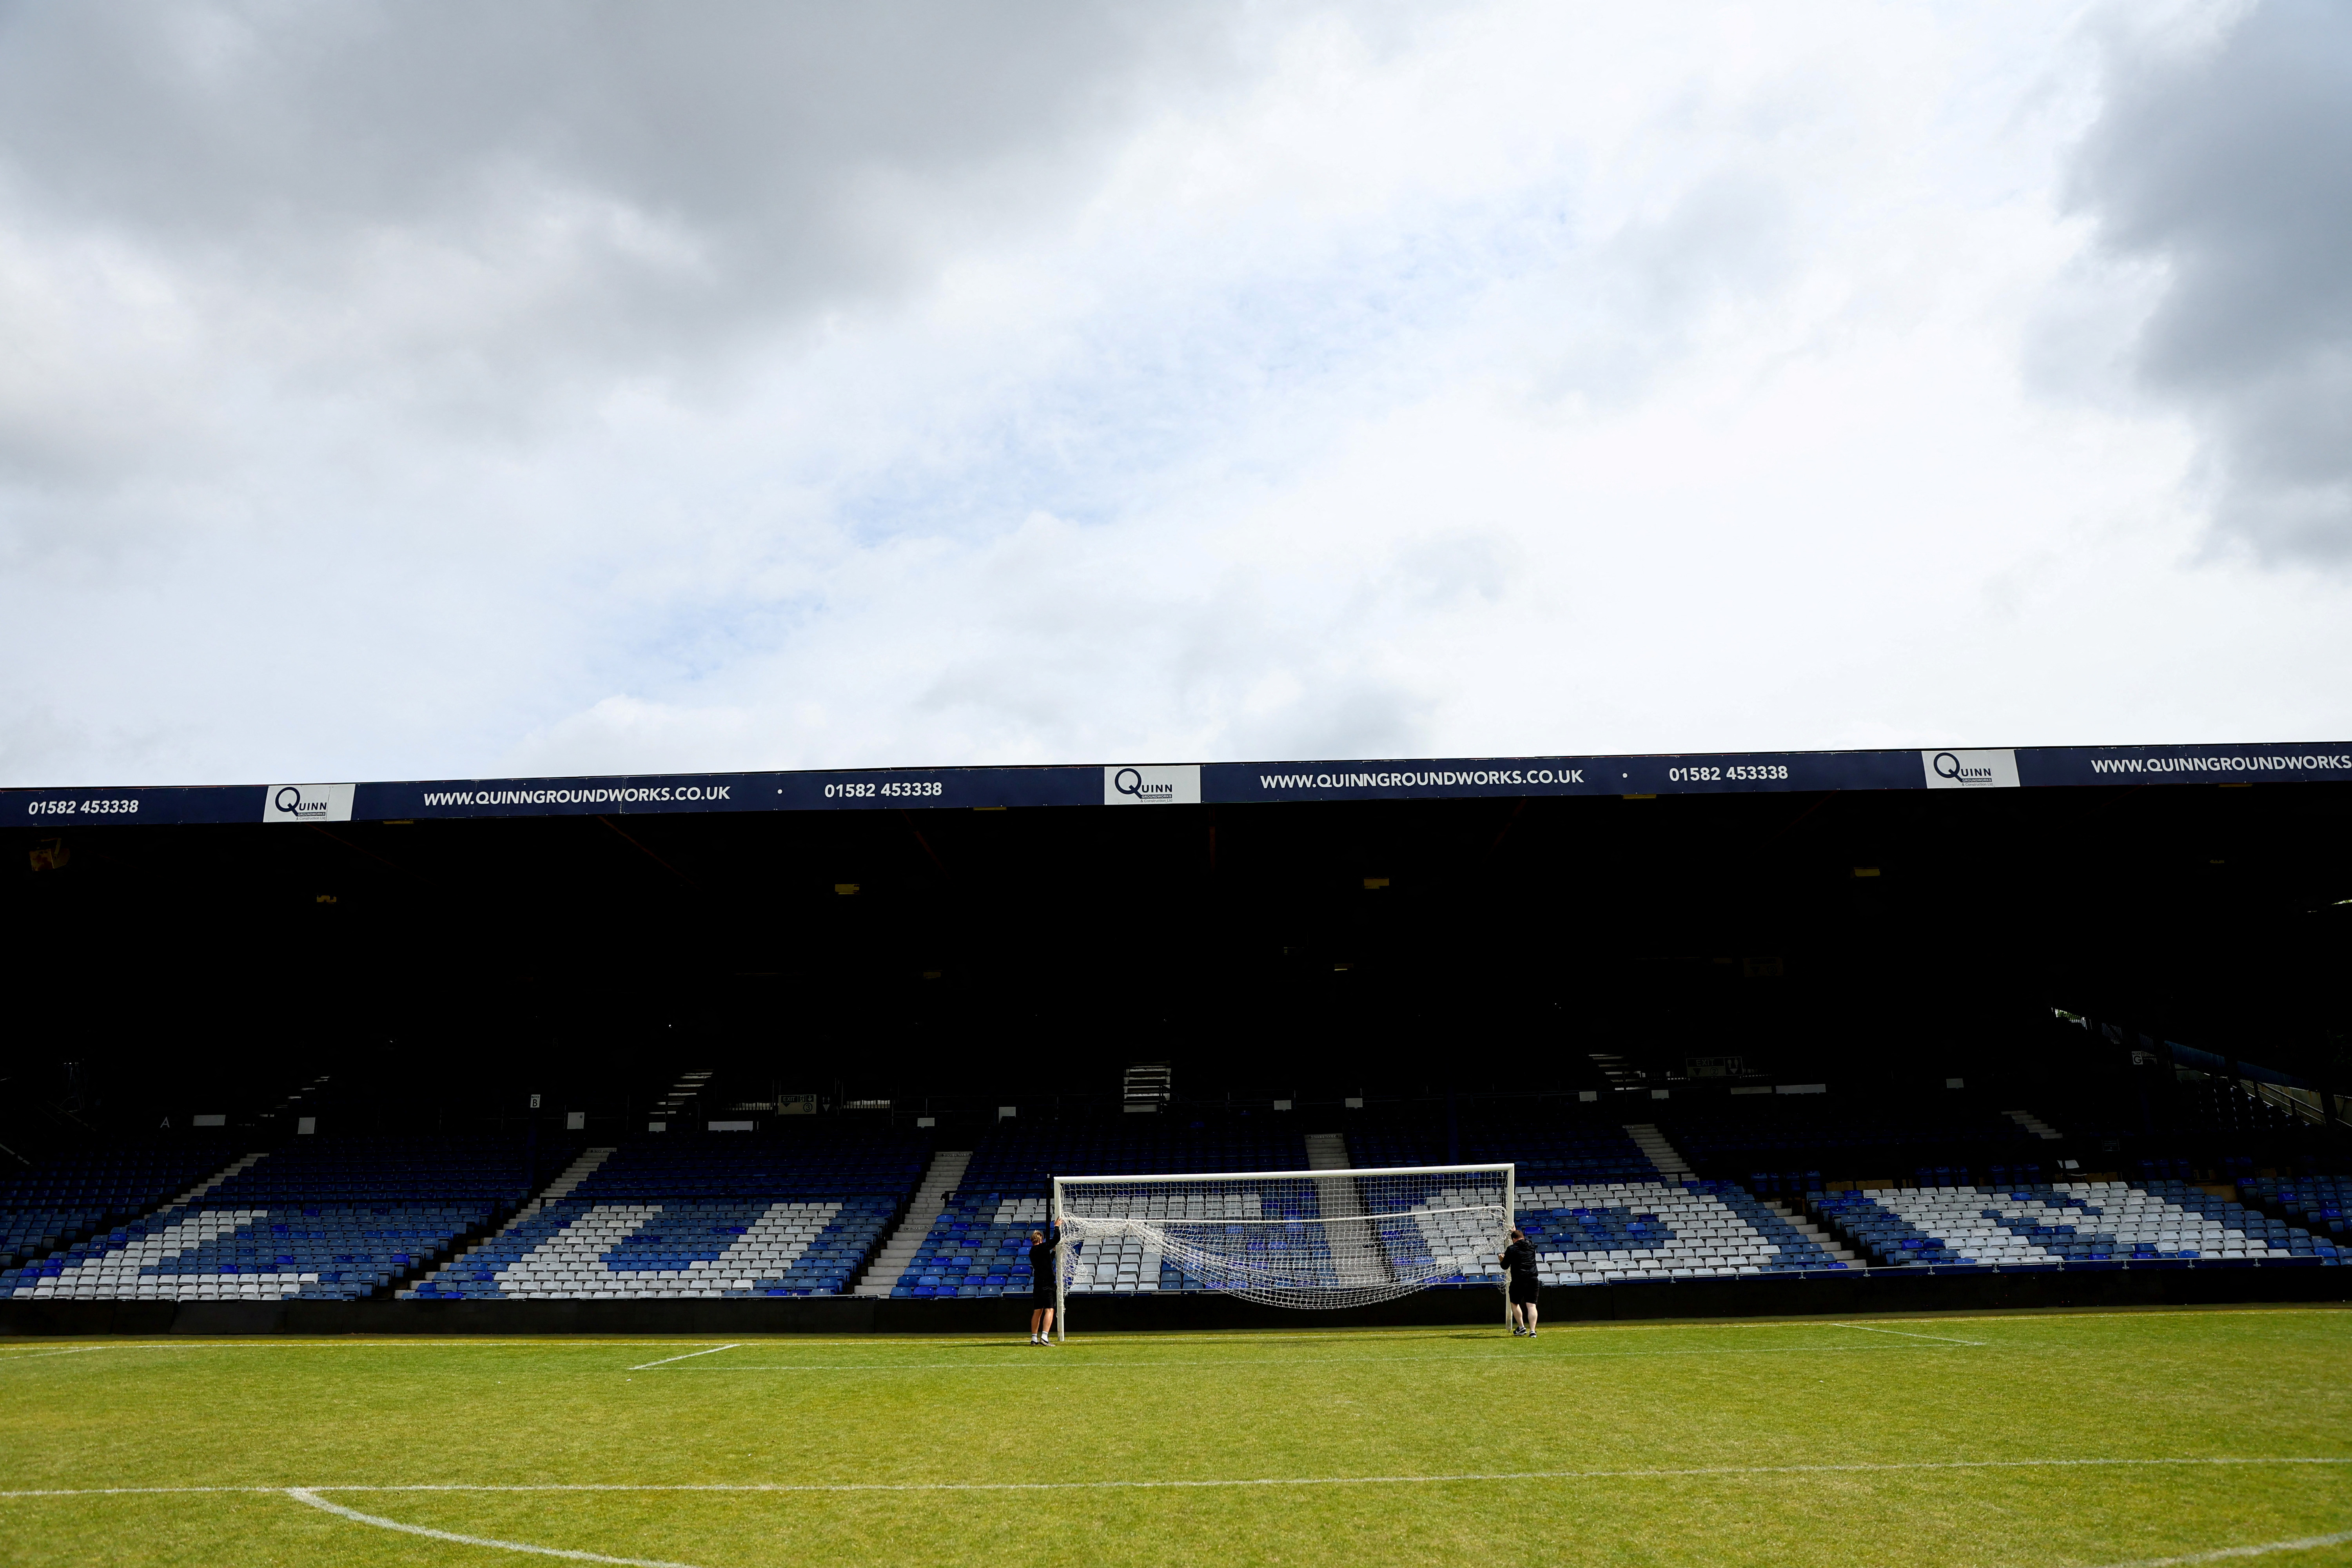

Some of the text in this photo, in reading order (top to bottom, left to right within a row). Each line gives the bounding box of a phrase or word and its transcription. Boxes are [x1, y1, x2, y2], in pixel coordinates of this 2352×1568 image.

[1669, 766, 1788, 781] 01582 453338
[1934, 752, 1991, 782] QUINN
[1114, 768, 1172, 799] QUINN
[1260, 769, 1584, 789] WWW.QUINNGROUNDWORKS.CO.UK
[423, 786, 731, 806] WWW.QUINNGROUNDWORKS.CO.UK
[825, 782, 942, 798] 01582 453338
[28, 800, 139, 815] 01582 453338
[275, 786, 327, 817] QUINN
[160, 1116, 170, 1128] A
